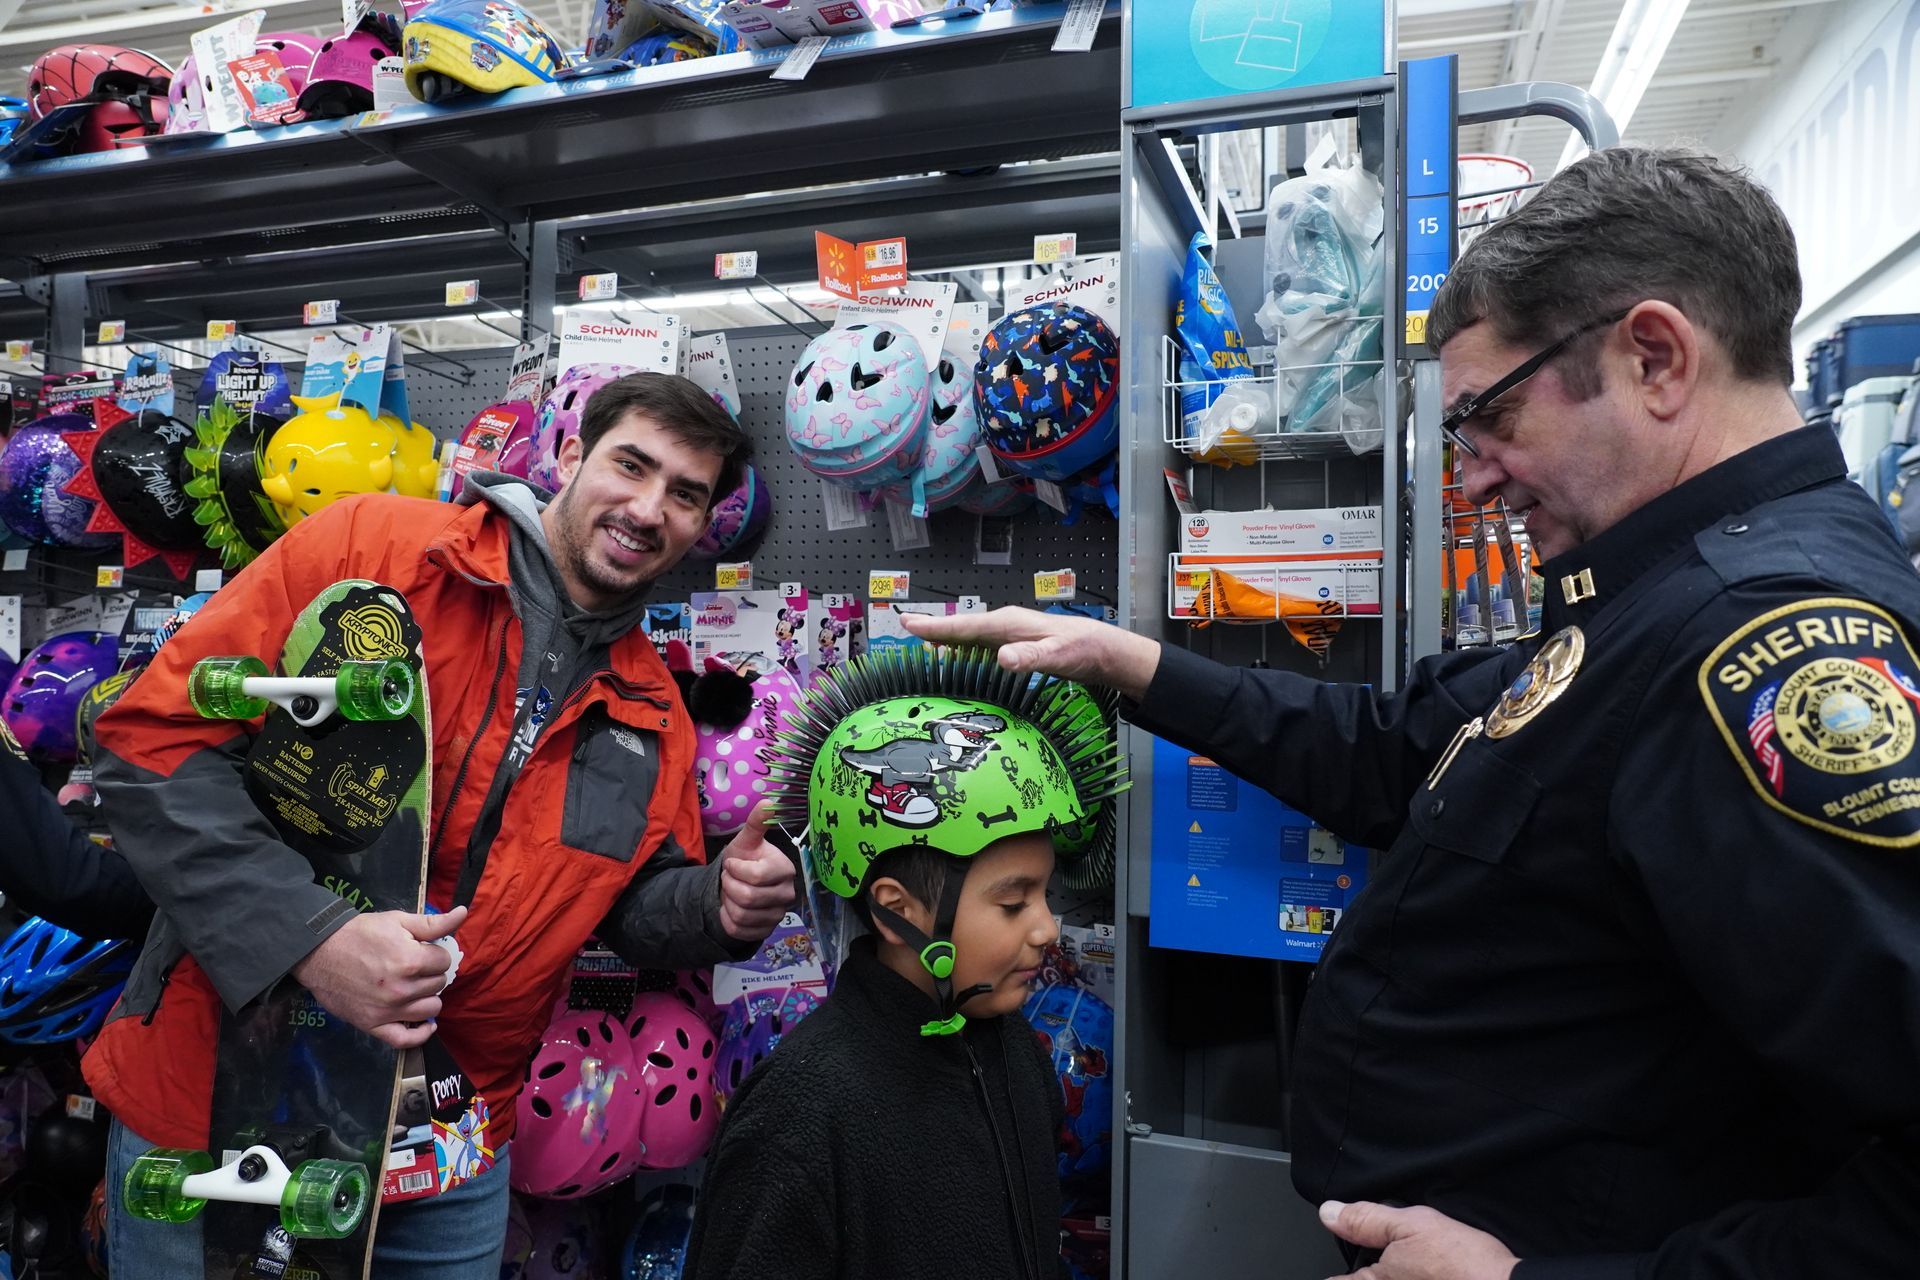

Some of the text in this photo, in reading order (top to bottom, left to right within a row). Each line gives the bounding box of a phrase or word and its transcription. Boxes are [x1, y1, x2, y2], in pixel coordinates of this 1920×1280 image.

[828, 36, 867, 50] shelf.
[1422, 159, 1434, 176] L
[1417, 217, 1439, 235] 15
[738, 255, 753, 269] 19.96
[880, 247, 897, 261] 16.96
[825, 275, 852, 295] Rollback
[871, 271, 904, 284] Rollback
[1024, 275, 1104, 305] SCHWINN
[841, 305, 899, 315] Infant Bike Helmet
[858, 295, 934, 309] SCHWINN
[564, 333, 622, 345] Child Bike Helmet
[580, 324, 659, 338] SCHWINN
[126, 372, 167, 391] Raskullz
[218, 375, 276, 390] LIGHT UP
[223, 390, 266, 401] HELMET
[1342, 509, 1376, 521] OMAR
[1191, 519, 1206, 528] 120
[1264, 524, 1278, 532] Free
[1279, 523, 1295, 532] Vinyl
[872, 580, 891, 594] 2996
[1038, 577, 1057, 593] 1996
[1260, 575, 1273, 583] Free
[696, 614, 735, 626] MINNIE
[345, 616, 401, 657] KRYPTONICS
[322, 646, 336, 658] SELF
[1718, 616, 1894, 692] SHERIFF
[1778, 661, 1892, 716] BLOUNT COUNTY
[753, 695, 782, 776] Minnie
[292, 740, 314, 760] NO
[1794, 719, 1911, 772] SHERIFF'S OFFICE
[279, 750, 313, 775] BATTERIES
[273, 759, 307, 784] REQUIRED
[252, 760, 311, 800] NEVER NEEDS CHARGING!
[345, 780, 389, 809] SPIN ME!
[1822, 783, 1885, 817] BLOUNT
[336, 797, 384, 828] SKATEBOARD
[344, 809, 368, 827] LIGHTS
[347, 820, 358, 829] UP!
[1286, 938, 1316, 949] Walmart
[741, 973, 794, 984] BIKE HELMET
[288, 1009, 326, 1028] 1965
[432, 1074, 461, 1110] POPPY
